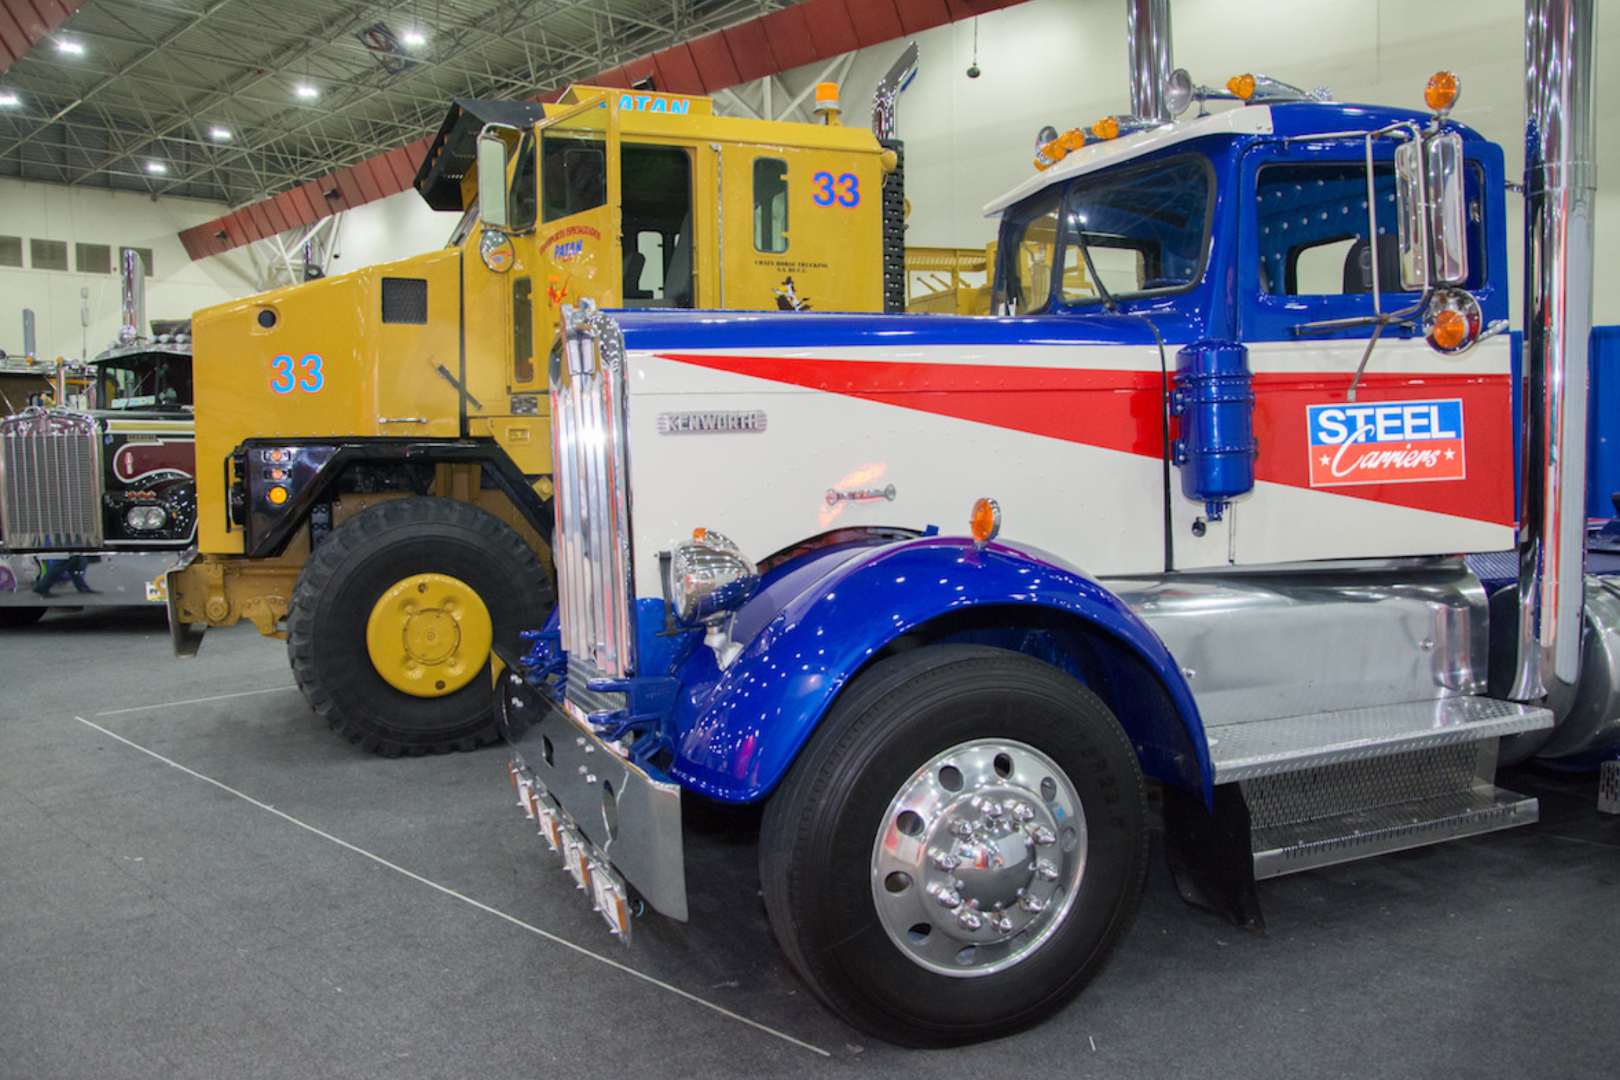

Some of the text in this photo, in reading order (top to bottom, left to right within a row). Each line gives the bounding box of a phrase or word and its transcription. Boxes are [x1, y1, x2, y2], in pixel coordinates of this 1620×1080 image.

[812, 170, 860, 208] 33
[271, 353, 324, 393] 33
[665, 412, 760, 432] KENWORTH
[1317, 404, 1457, 445] STEEL
[1330, 423, 1442, 478] Carriers
